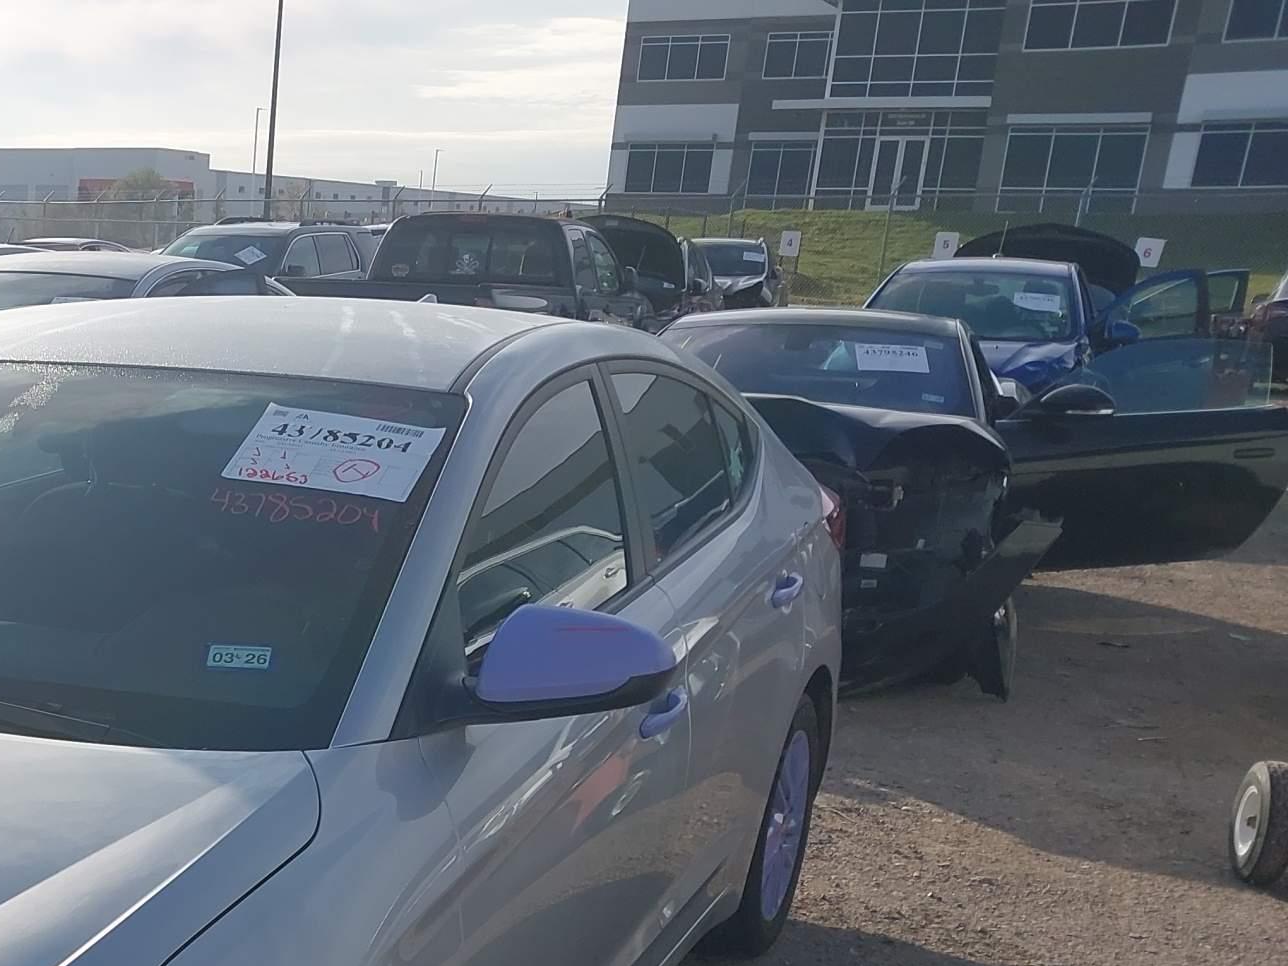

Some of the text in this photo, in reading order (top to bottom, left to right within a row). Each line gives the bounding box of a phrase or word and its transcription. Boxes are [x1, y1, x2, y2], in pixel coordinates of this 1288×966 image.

[211, 487, 380, 532] 43785204
[212, 652, 268, 665] 03 26
